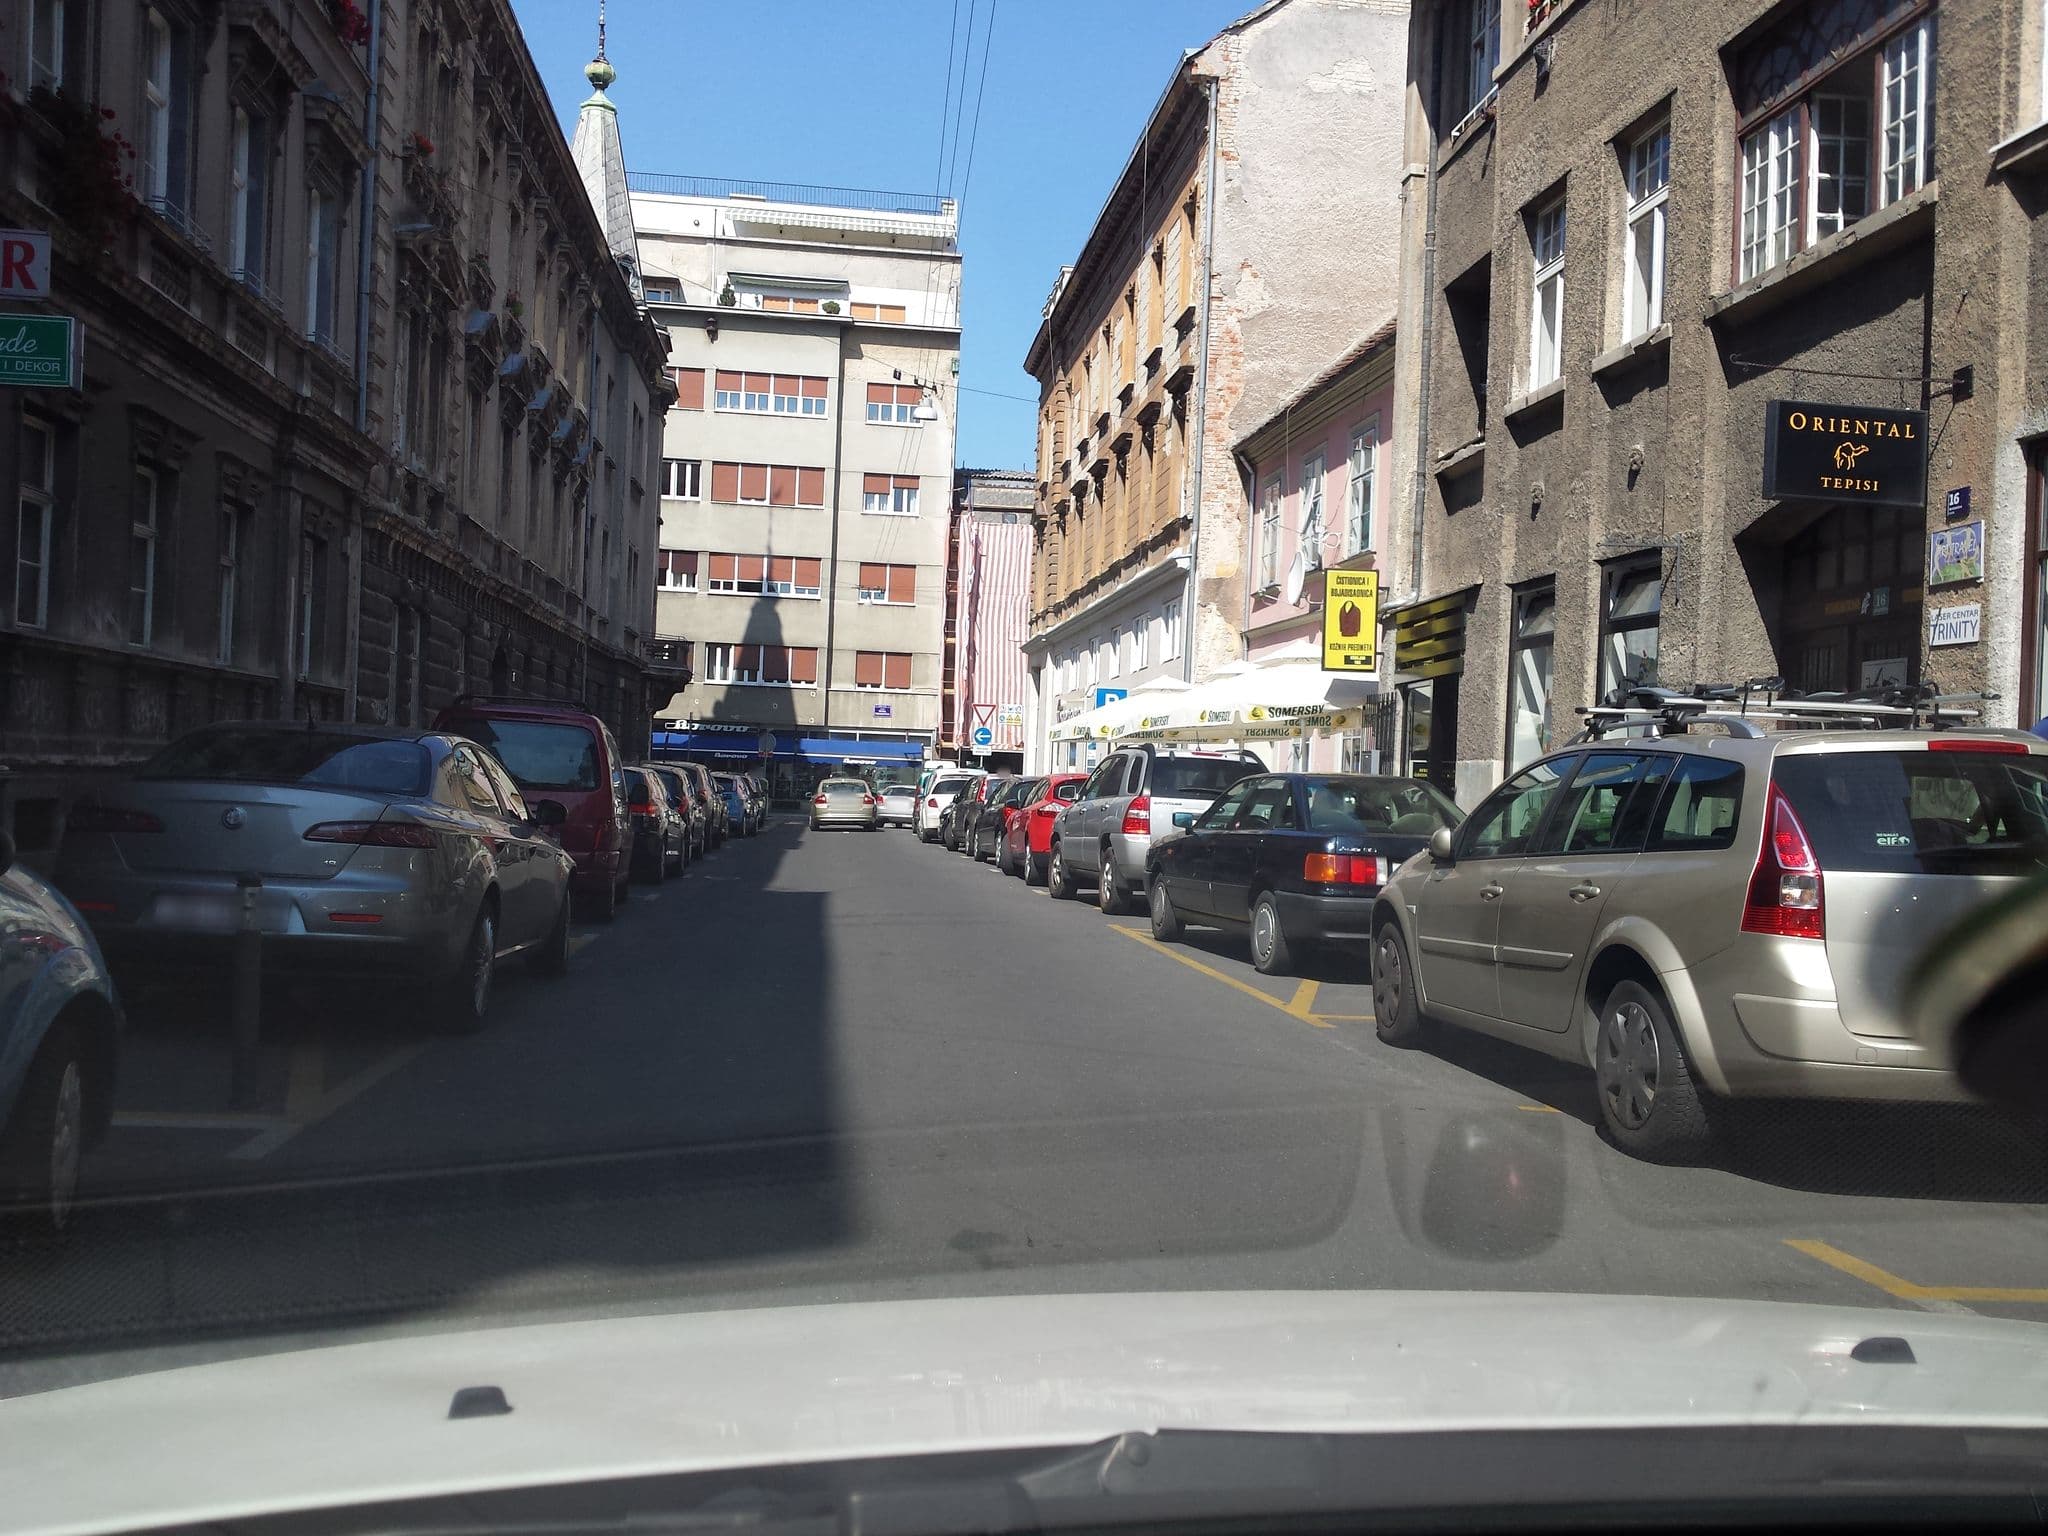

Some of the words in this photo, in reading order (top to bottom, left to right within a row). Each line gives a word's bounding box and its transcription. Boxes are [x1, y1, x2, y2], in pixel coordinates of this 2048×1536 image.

[1, 239, 38, 290] R
[15, 361, 61, 373] DEKOR
[1789, 412, 1916, 439] ORIENTAL
[1821, 477, 1880, 491] TEPISI
[1949, 492, 1960, 506] 16
[1875, 594, 1887, 607] 16
[1952, 608, 1979, 620] CENTAR
[1930, 619, 1978, 641] TRINITY
[1268, 704, 1325, 719] SOMERSBY
